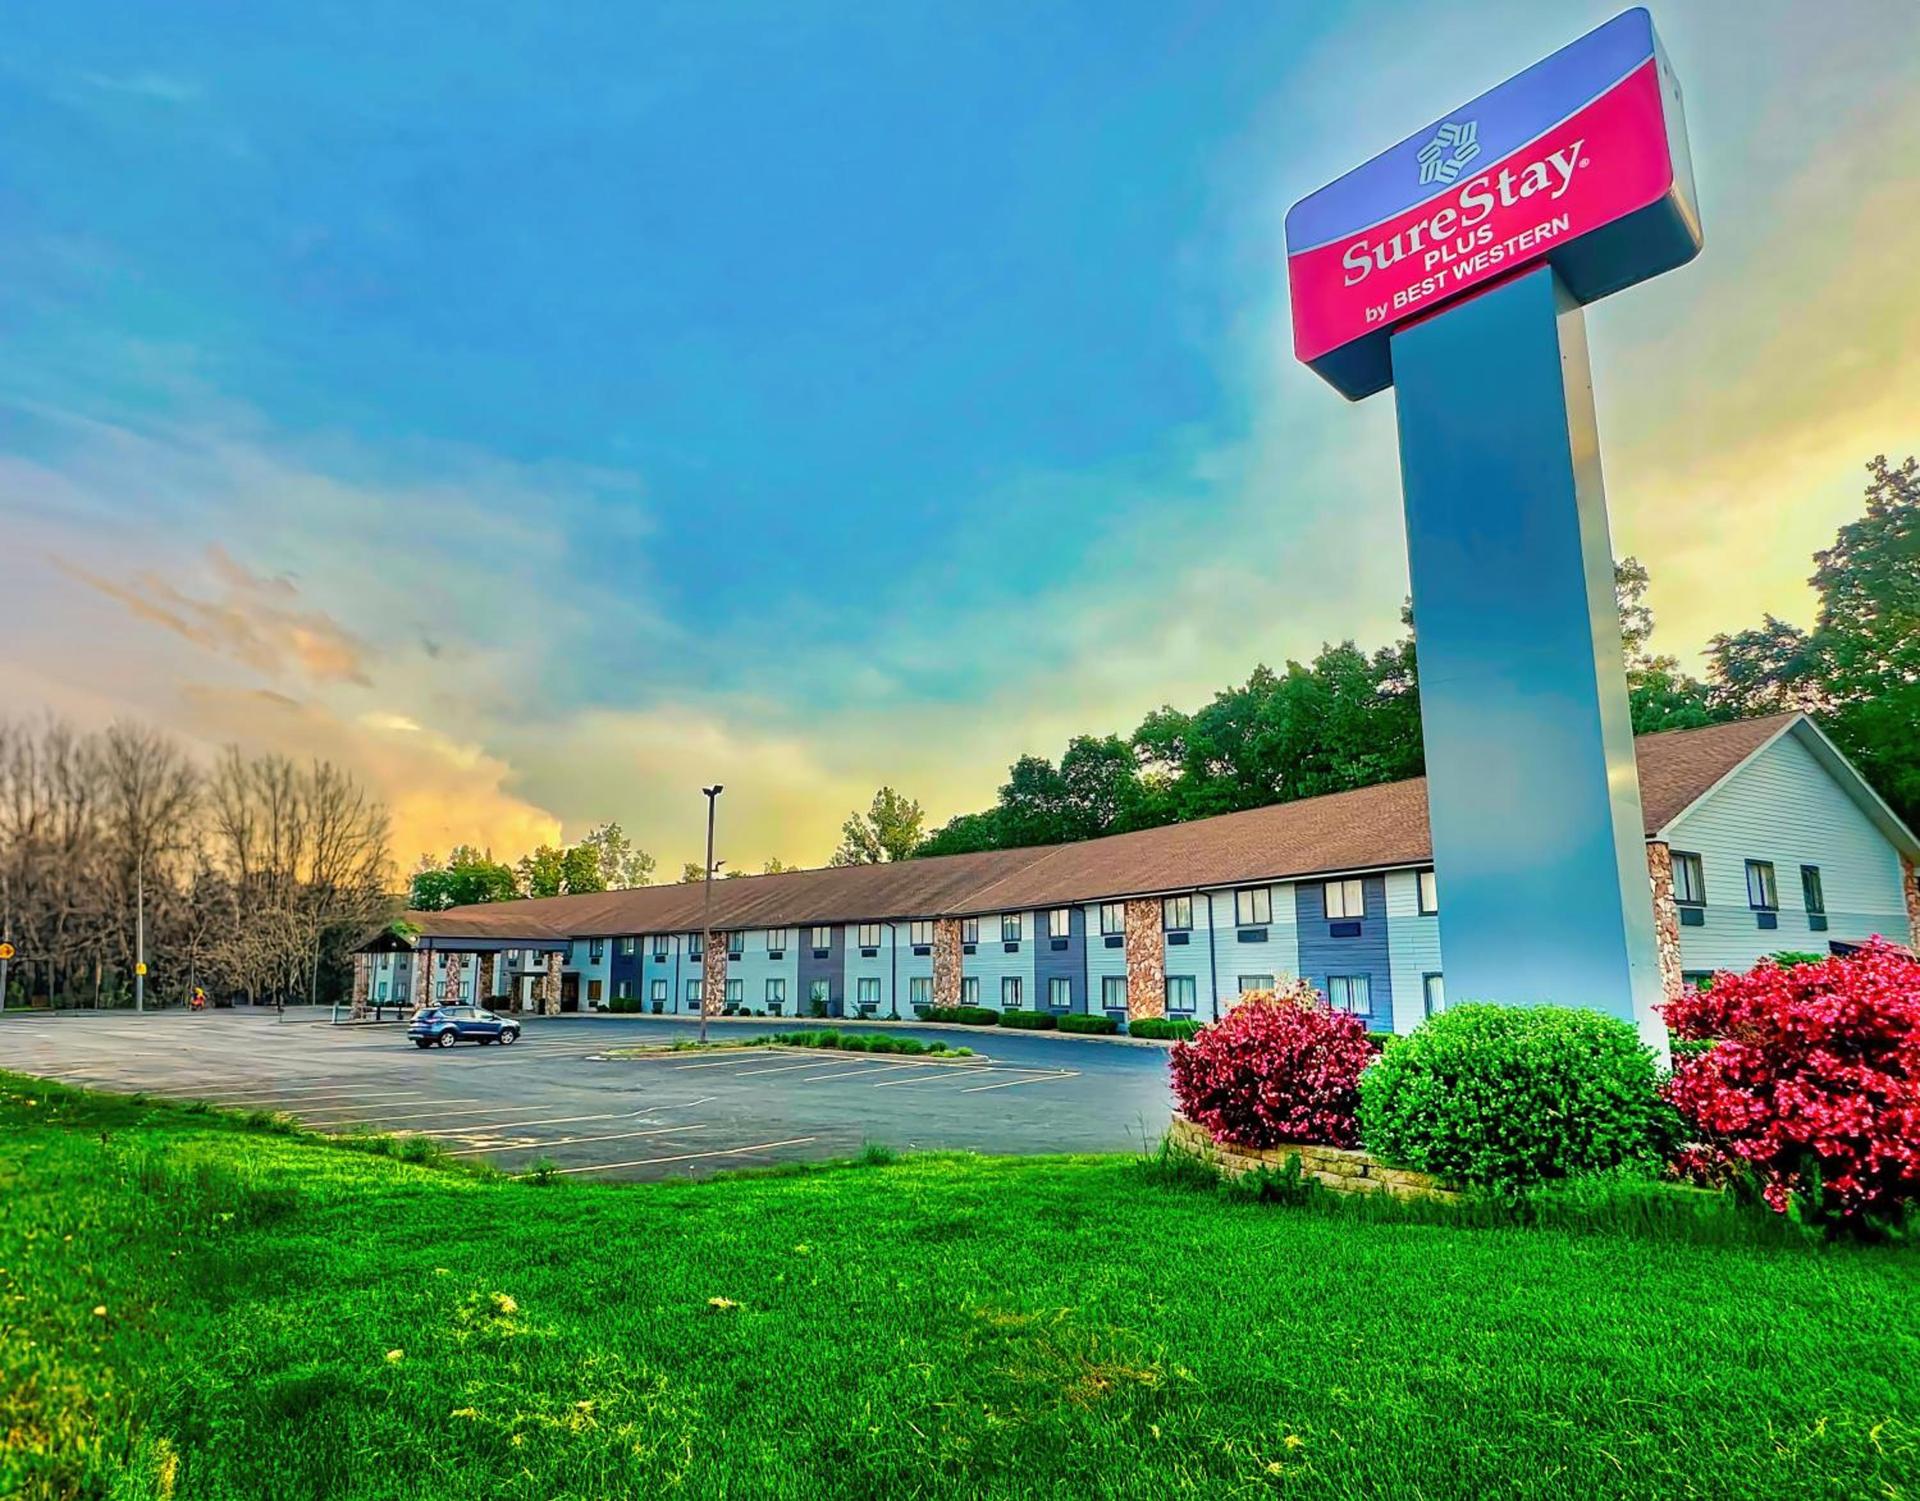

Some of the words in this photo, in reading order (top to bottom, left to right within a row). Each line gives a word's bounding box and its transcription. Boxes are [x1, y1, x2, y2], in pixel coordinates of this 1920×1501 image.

[1365, 302, 1388, 323] by
[1394, 271, 1447, 309] BEST
[1453, 213, 1570, 280] WESTERN
[1424, 224, 1494, 271] PLUS
